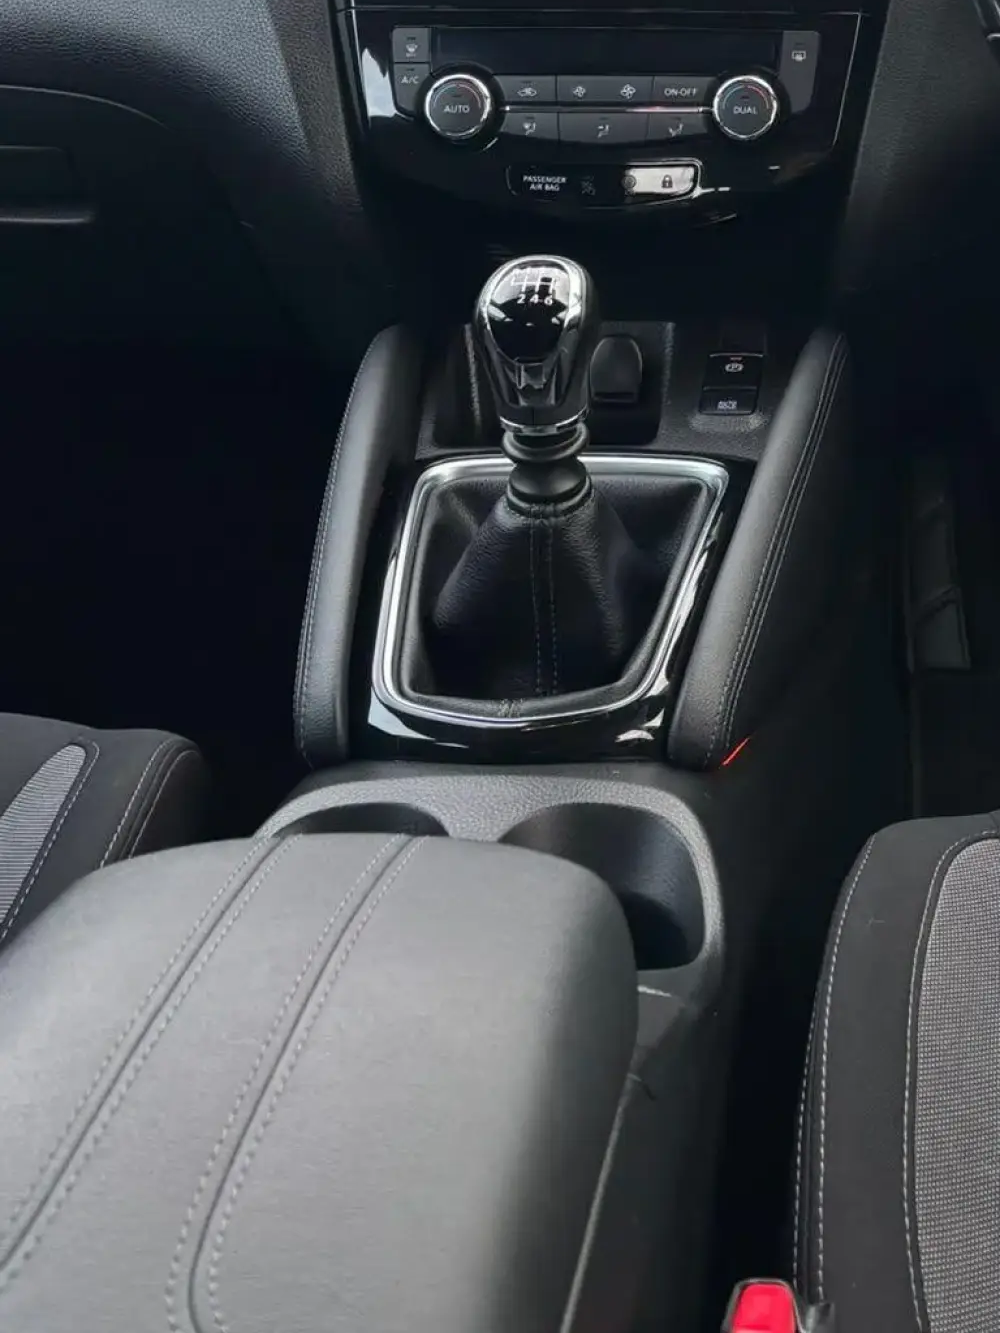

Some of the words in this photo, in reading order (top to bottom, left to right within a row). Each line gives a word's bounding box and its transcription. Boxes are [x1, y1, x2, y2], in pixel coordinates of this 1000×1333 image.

[401, 75, 420, 84] A/C
[664, 87, 697, 96] ON-OFF
[443, 104, 470, 114] AUTO
[733, 105, 758, 115] DUAL
[522, 175, 567, 184] PASSENGER
[544, 184, 560, 192] BAG
[517, 293, 526, 304] 2
[530, 293, 539, 304] 4
[544, 294, 553, 305] 6
